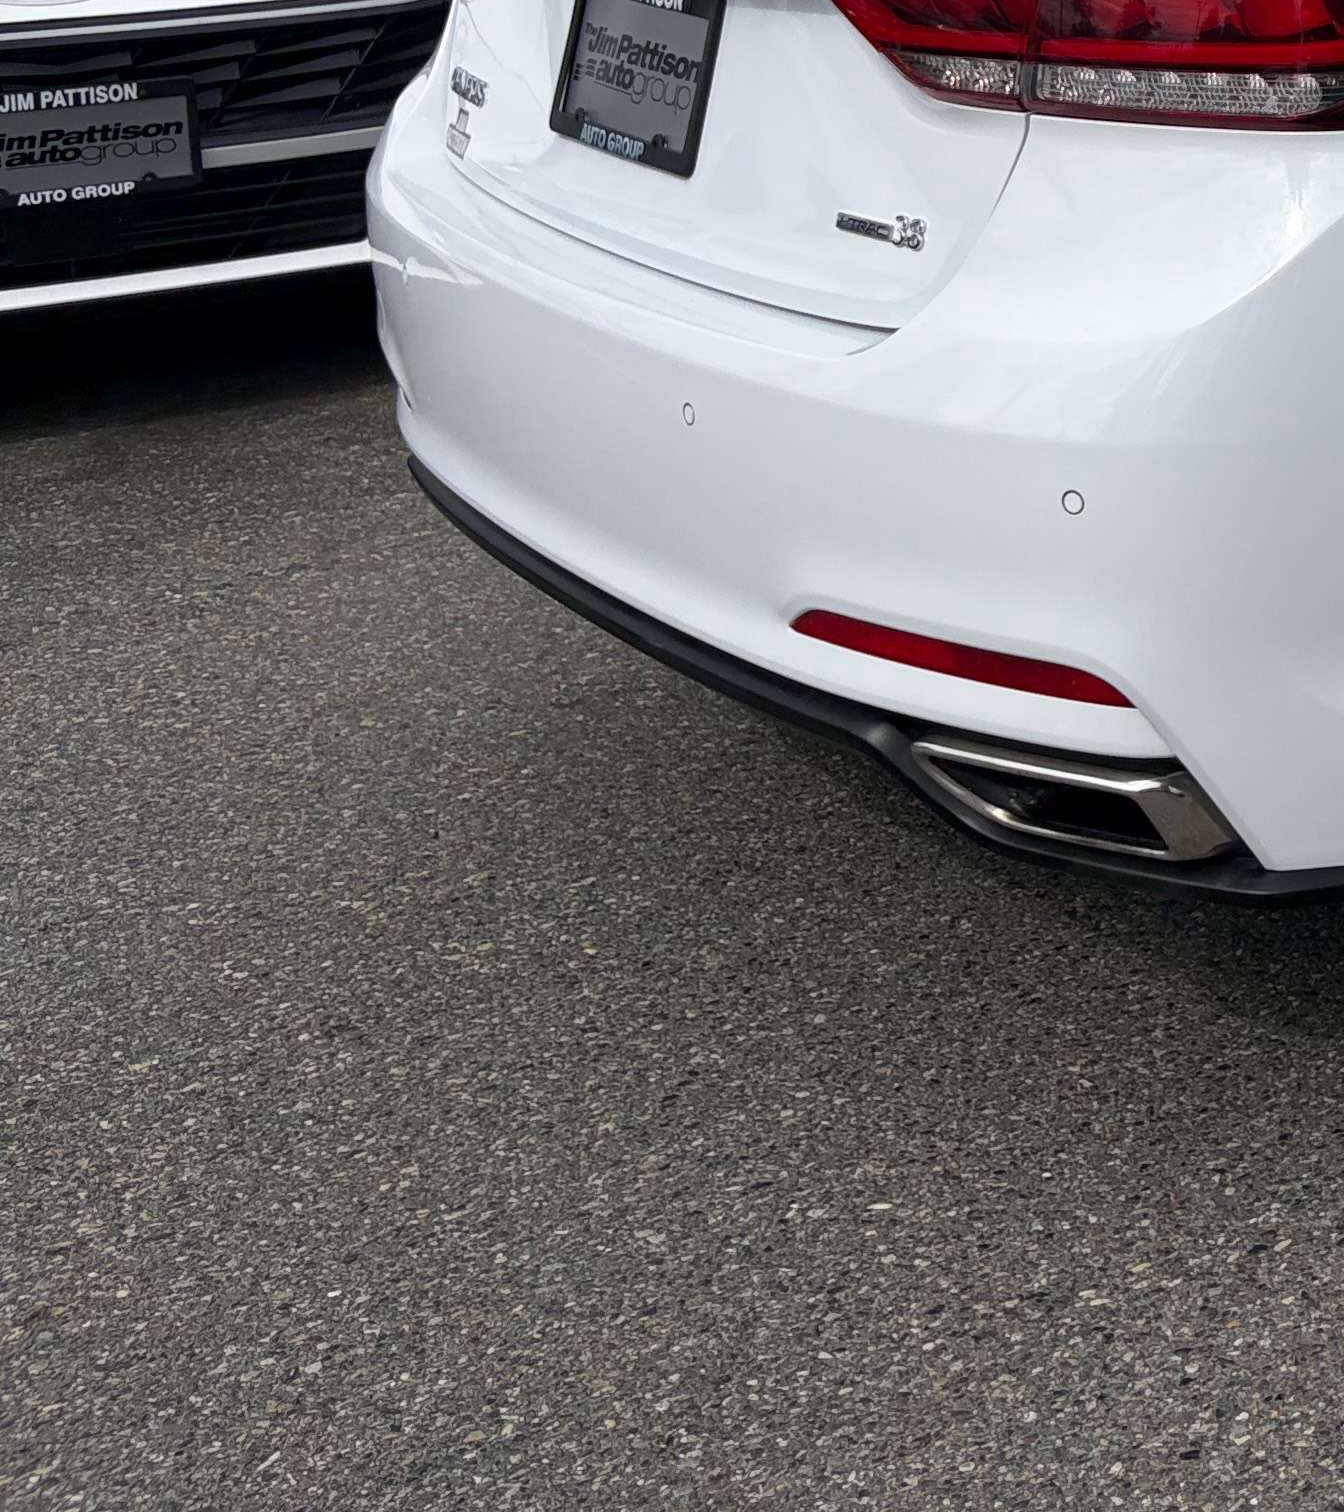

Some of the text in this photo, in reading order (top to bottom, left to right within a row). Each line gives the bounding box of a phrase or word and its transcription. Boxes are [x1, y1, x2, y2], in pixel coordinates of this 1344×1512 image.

[0, 82, 138, 113] JIM PATTISON
[580, 122, 645, 161] AUTO GROUP
[17, 180, 136, 207] AUTO GROUP
